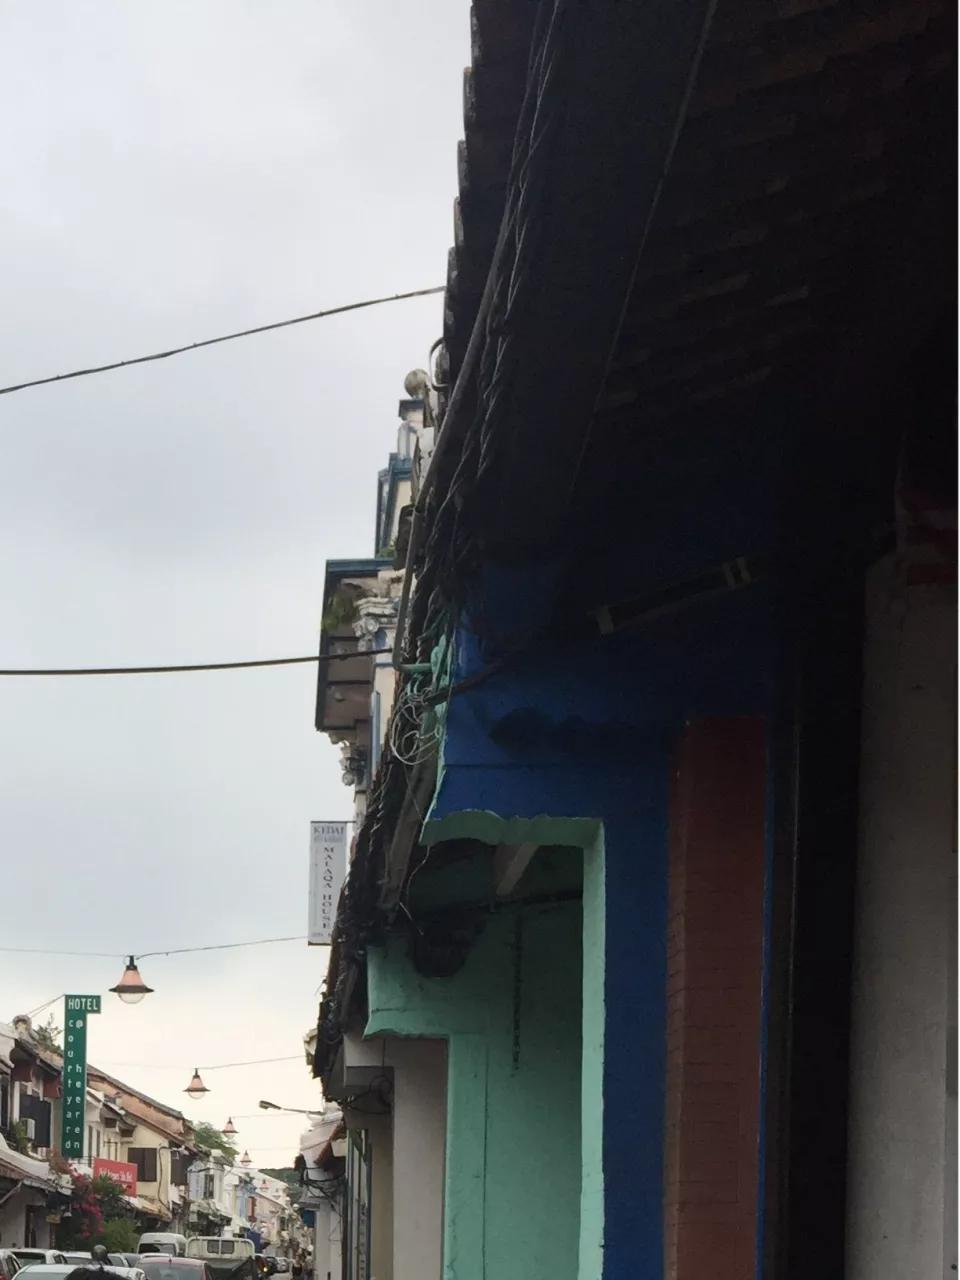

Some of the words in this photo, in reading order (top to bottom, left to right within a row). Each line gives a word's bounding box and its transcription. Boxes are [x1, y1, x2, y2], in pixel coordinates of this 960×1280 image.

[68, 998, 98, 1010] HOTEL
[65, 1019, 74, 1149] courtyard
[74, 1064, 82, 1149] heeren
